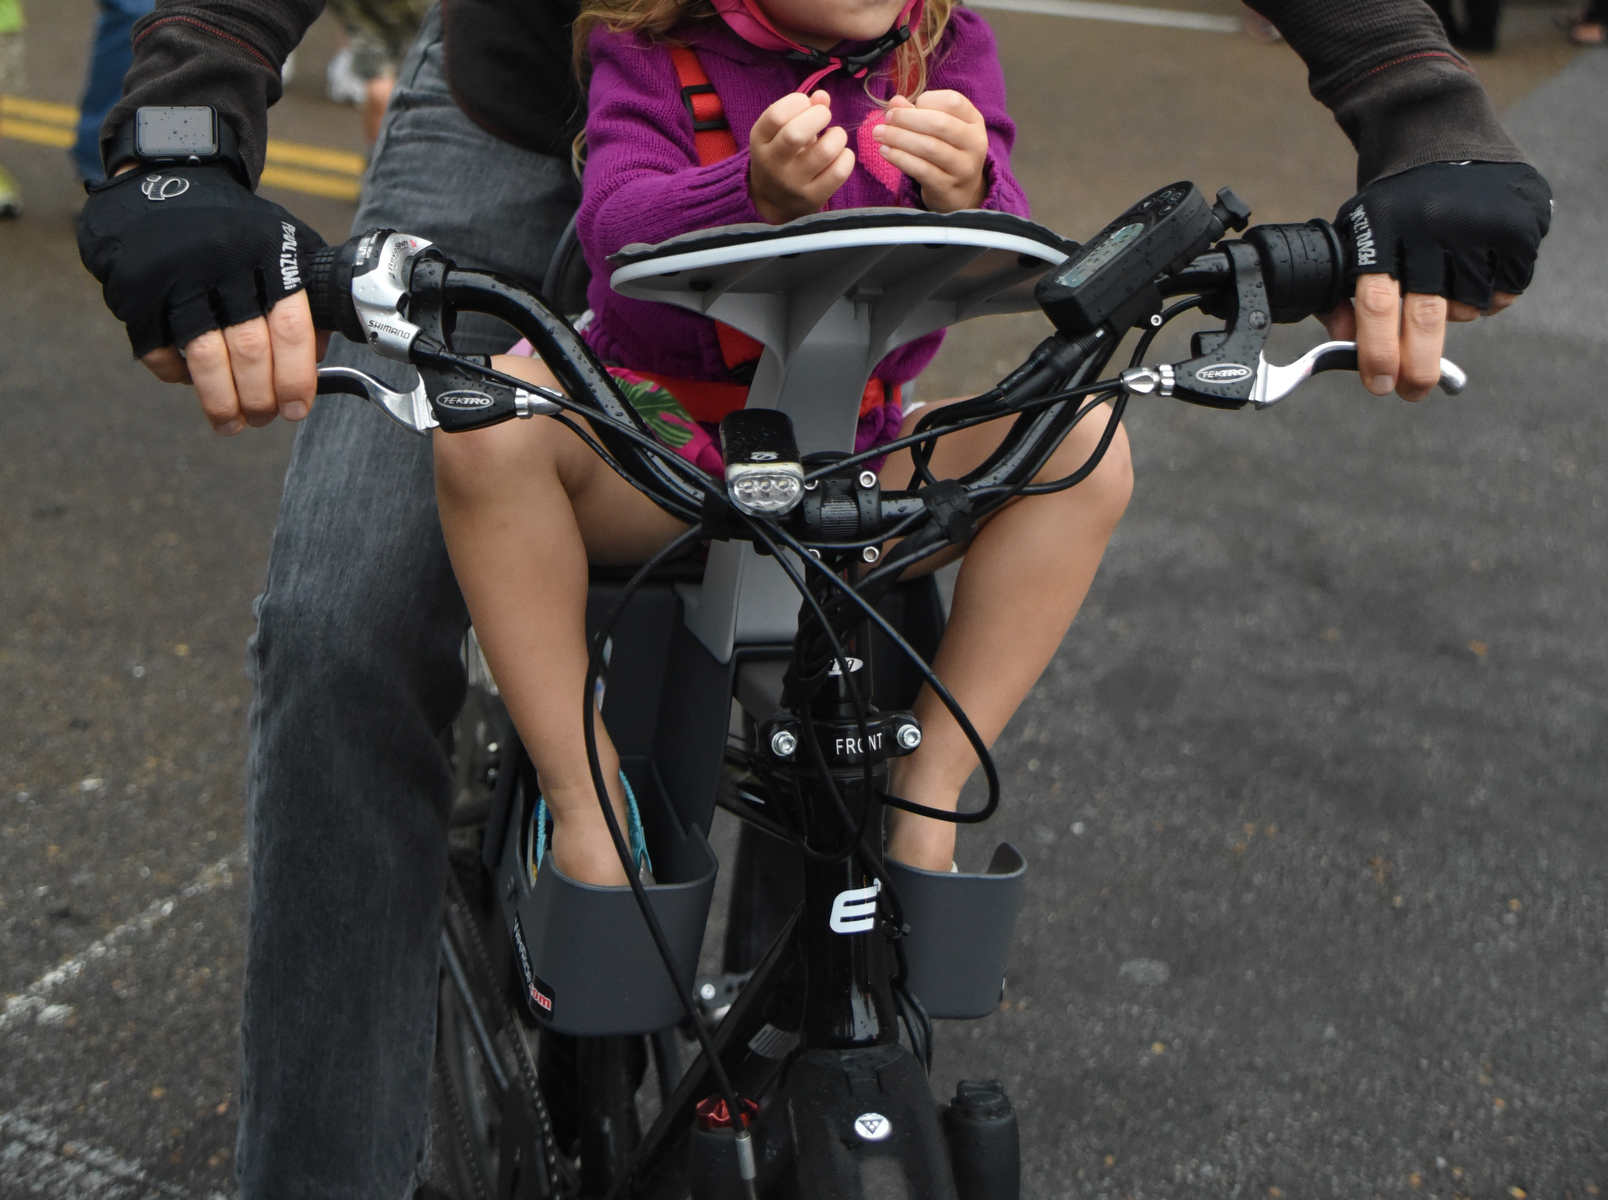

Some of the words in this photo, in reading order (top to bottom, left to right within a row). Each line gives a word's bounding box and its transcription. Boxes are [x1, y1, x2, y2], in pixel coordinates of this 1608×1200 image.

[367, 319, 411, 340] SHIMANO
[1201, 368, 1248, 379] TEKTRO
[442, 396, 491, 405] TEKTRO
